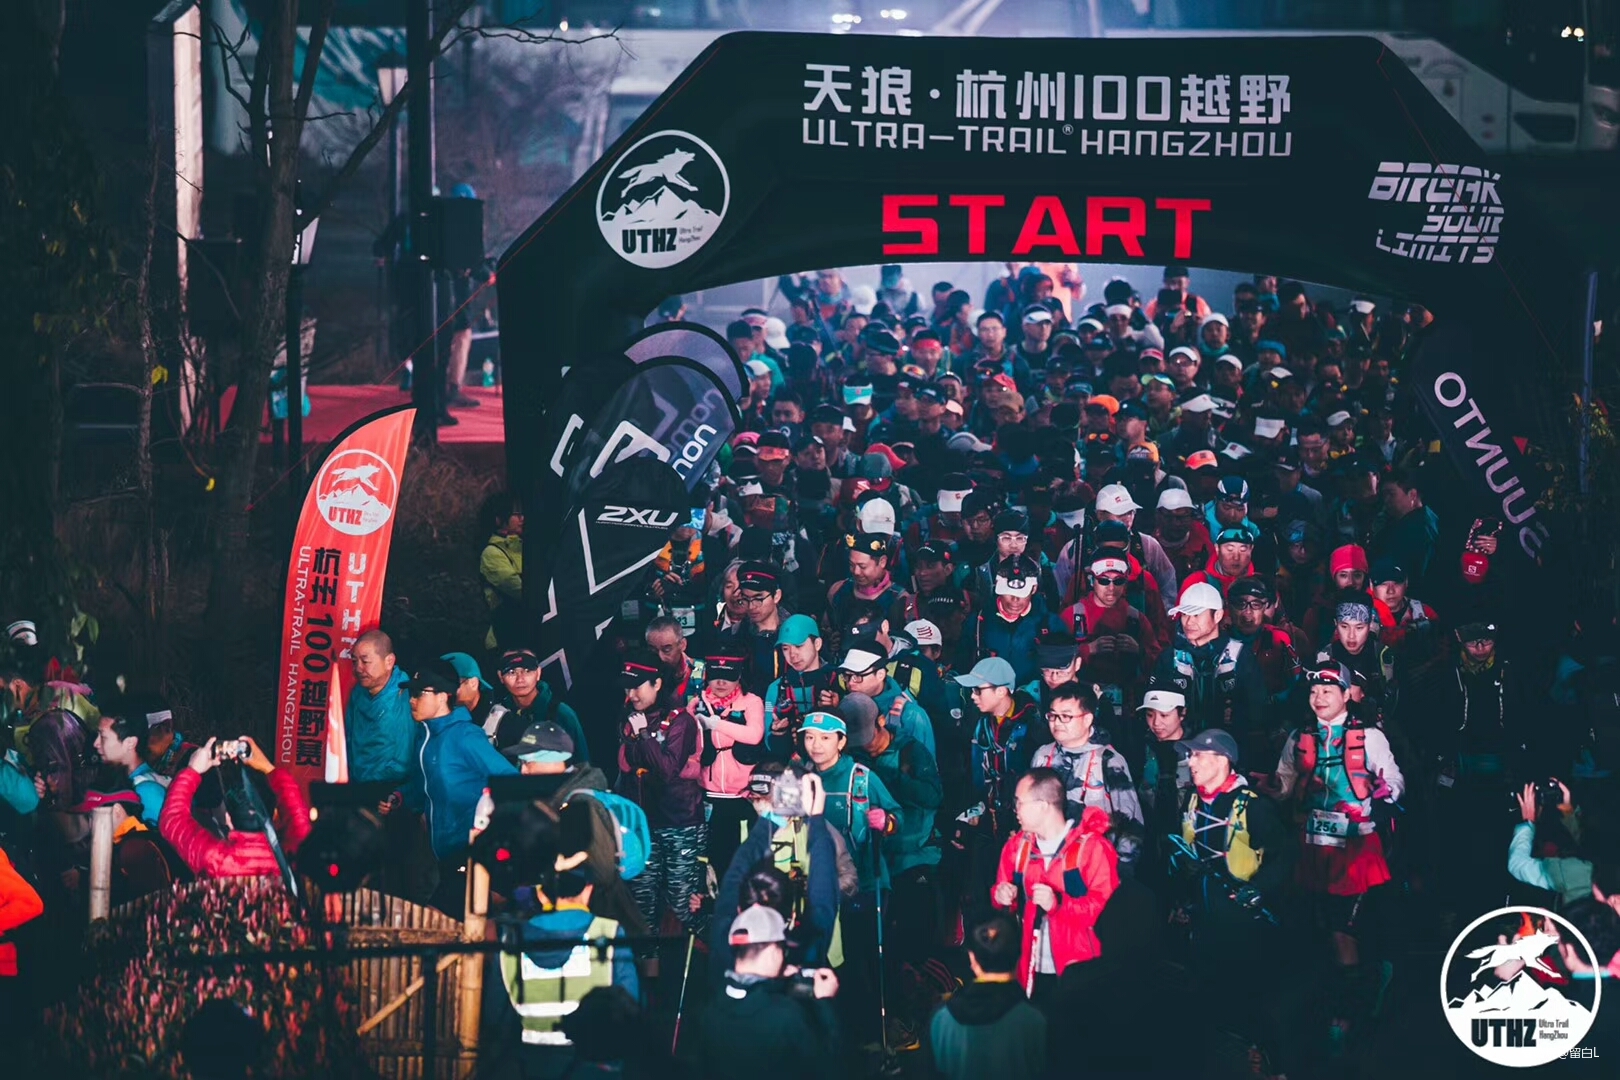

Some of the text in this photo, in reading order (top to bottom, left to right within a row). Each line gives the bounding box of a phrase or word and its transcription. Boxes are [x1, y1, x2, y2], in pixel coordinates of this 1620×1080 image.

[1081, 129, 1292, 157] HANGZHOU
[1368, 161, 1502, 204] BREAK
[882, 194, 1212, 259] START
[1422, 205, 1504, 233] YOUR
[622, 227, 677, 254] UTHZ
[1376, 228, 1499, 263] LIMITS
[328, 506, 363, 525] UTHZ
[597, 505, 679, 526] 2XU
[281, 546, 311, 763] ULTRA-TRAIL HANGZHOU
